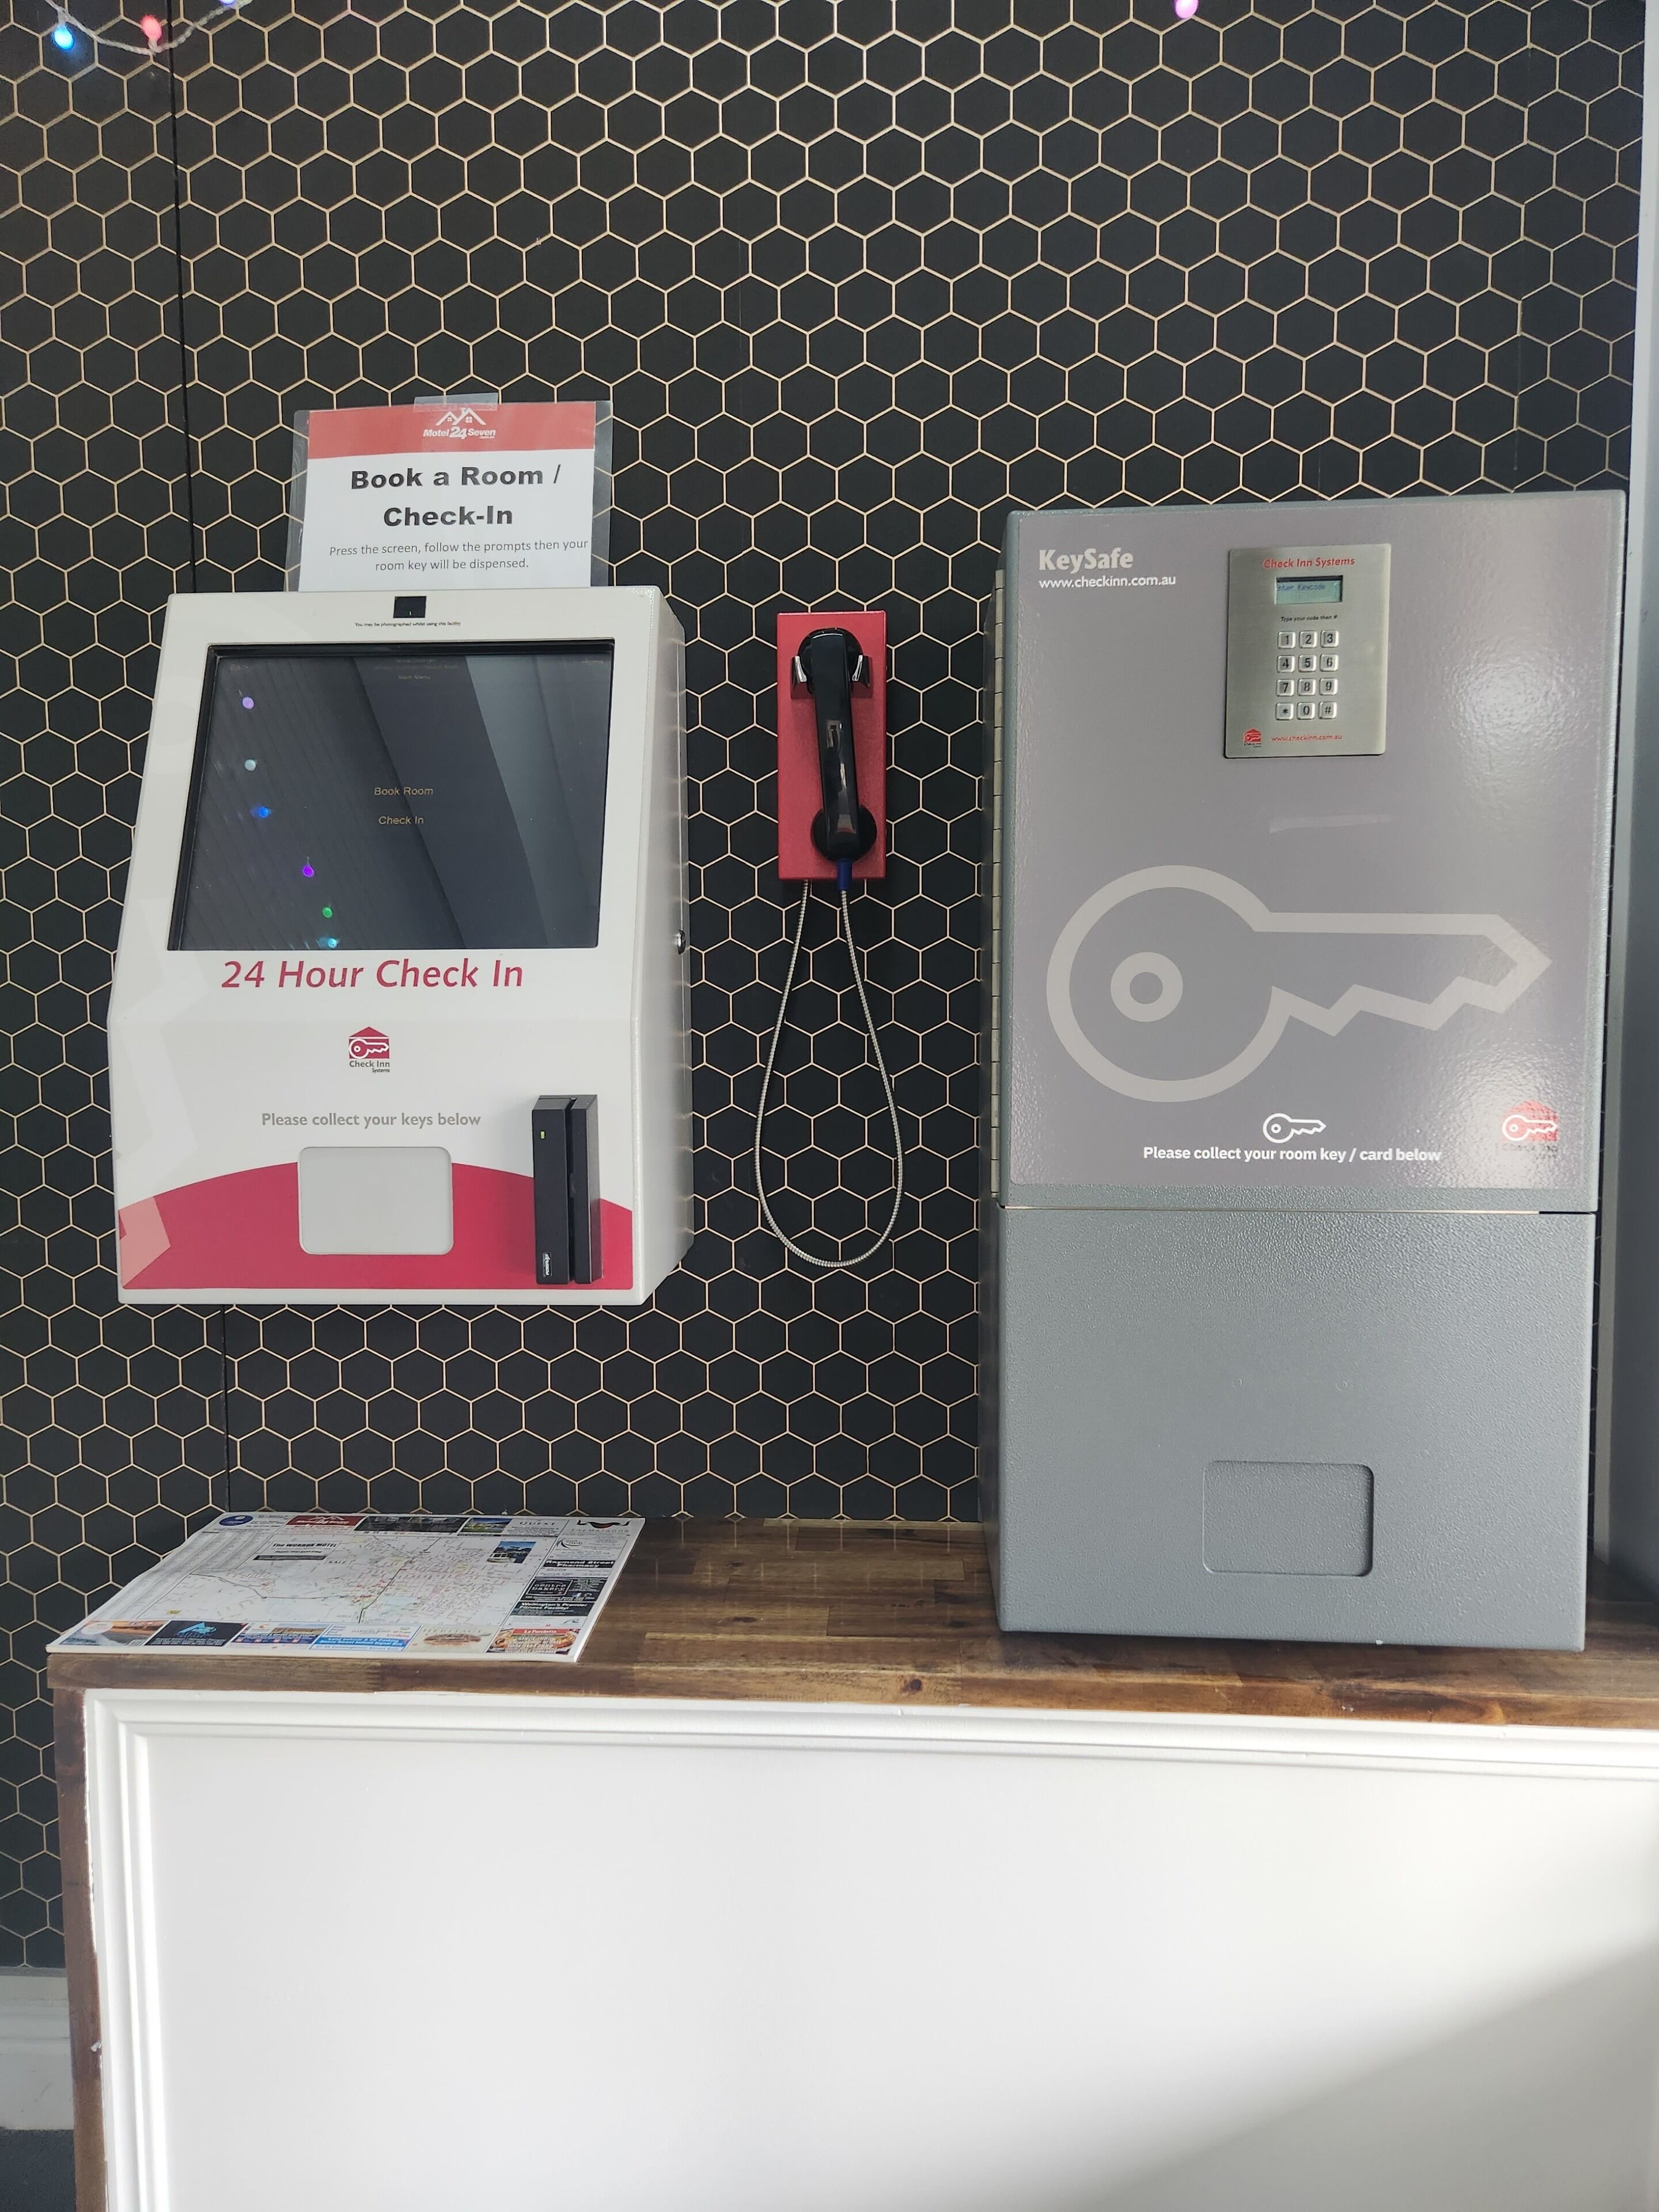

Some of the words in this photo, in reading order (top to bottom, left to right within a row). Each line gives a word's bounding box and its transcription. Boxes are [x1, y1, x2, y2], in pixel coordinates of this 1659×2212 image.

[423, 429, 449, 437] Motel
[467, 428, 496, 436] Seven
[351, 468, 423, 490] Book
[433, 471, 449, 486] a
[461, 466, 543, 486] Room
[552, 464, 560, 484] /
[384, 505, 513, 526] Check-In
[329, 547, 358, 556] Press
[361, 544, 378, 554] the
[382, 545, 421, 554] screen,
[425, 542, 459, 552] follow
[463, 541, 480, 552] the
[484, 541, 531, 553] prompts
[535, 540, 559, 550] then
[563, 540, 588, 551] your
[376, 562, 404, 571] room
[408, 560, 427, 571] key
[430, 559, 449, 570] will
[453, 559, 466, 569] be
[469, 558, 529, 570] dispensed.
[1039, 547, 1134, 574] KeySafe
[1263, 558, 1294, 569] Check
[1297, 559, 1312, 567] Inn
[1315, 558, 1355, 569] Systems
[1039, 575, 1176, 589] www.checkinn.com.au
[1285, 635, 1289, 645] 1
[1305, 634, 1312, 644] 2
[1327, 633, 1333, 643] 3
[1282, 658, 1289, 669] 4
[1304, 658, 1311, 668] 5
[1327, 658, 1332, 667] 6
[1283, 683, 1289, 692] 7
[1304, 682, 1310, 691] 8
[1326, 681, 1332, 691] 9
[1303, 706, 1310, 715] 0
[374, 787, 400, 796] Book
[404, 787, 433, 795] Room
[378, 816, 412, 824] Check
[415, 816, 425, 824] In
[222, 960, 264, 988] 24
[278, 960, 364, 988] Hour
[377, 958, 478, 987] Check
[493, 960, 523, 987] In
[262, 1113, 308, 1126] Please
[312, 1113, 360, 1126] collect
[363, 1115, 397, 1129] your
[402, 1113, 433, 1129] keys
[438, 1113, 481, 1126] below
[1143, 1147, 1191, 1159] Please
[1194, 1147, 1241, 1159] collect
[1244, 1150, 1276, 1162] your
[1279, 1150, 1317, 1160] room
[1320, 1147, 1347, 1163] key
[1349, 1147, 1357, 1162] /
[1359, 1148, 1393, 1161] card
[1396, 1148, 1441, 1161] below
